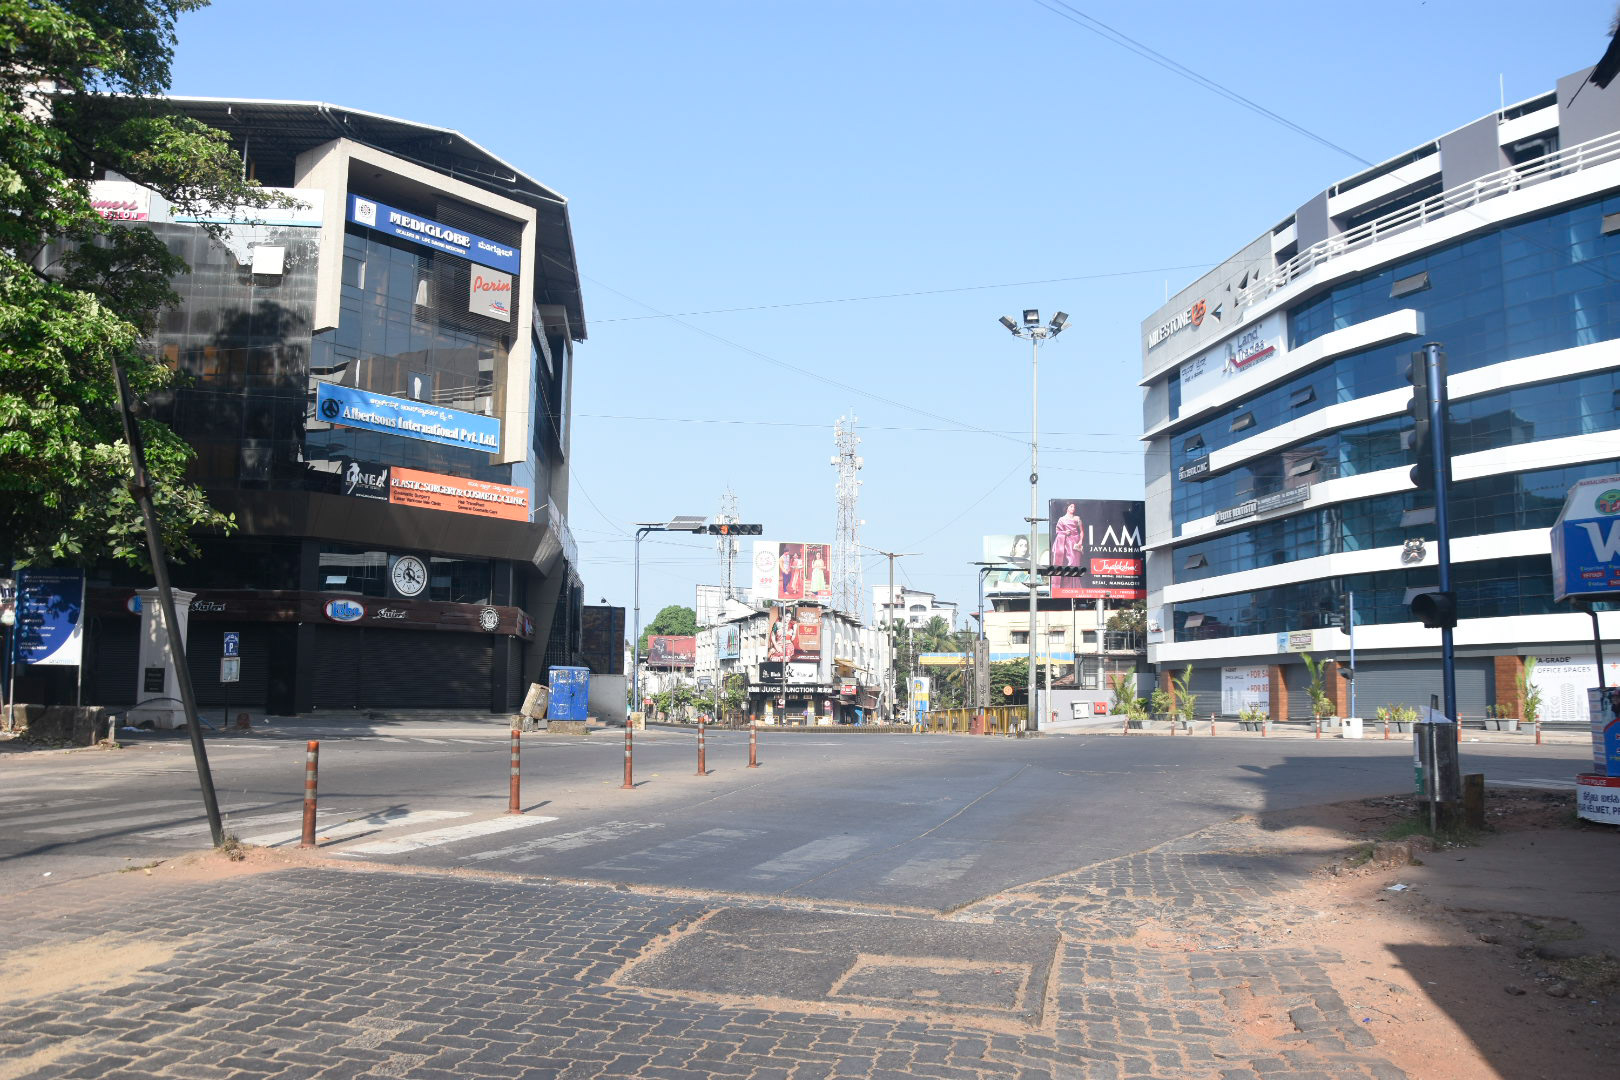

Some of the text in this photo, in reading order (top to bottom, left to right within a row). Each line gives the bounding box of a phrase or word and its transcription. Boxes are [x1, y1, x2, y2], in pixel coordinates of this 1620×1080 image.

[390, 211, 471, 248] MEDIGLOBE
[473, 275, 511, 293] Parin
[1148, 307, 1192, 349] MILESTONE
[1237, 326, 1259, 349] Land
[1237, 340, 1265, 362] Trades
[342, 405, 396, 428] Albertsons
[397, 416, 460, 440] International
[460, 428, 479, 444] Pvt.
[479, 431, 498, 447] Ltd.
[391, 478, 425, 491] PLASTIC
[424, 482, 457, 496] SURGERY
[464, 490, 503, 504] COSMETIC
[502, 495, 527, 507] CLINIC
[1088, 524, 1142, 546] I AM
